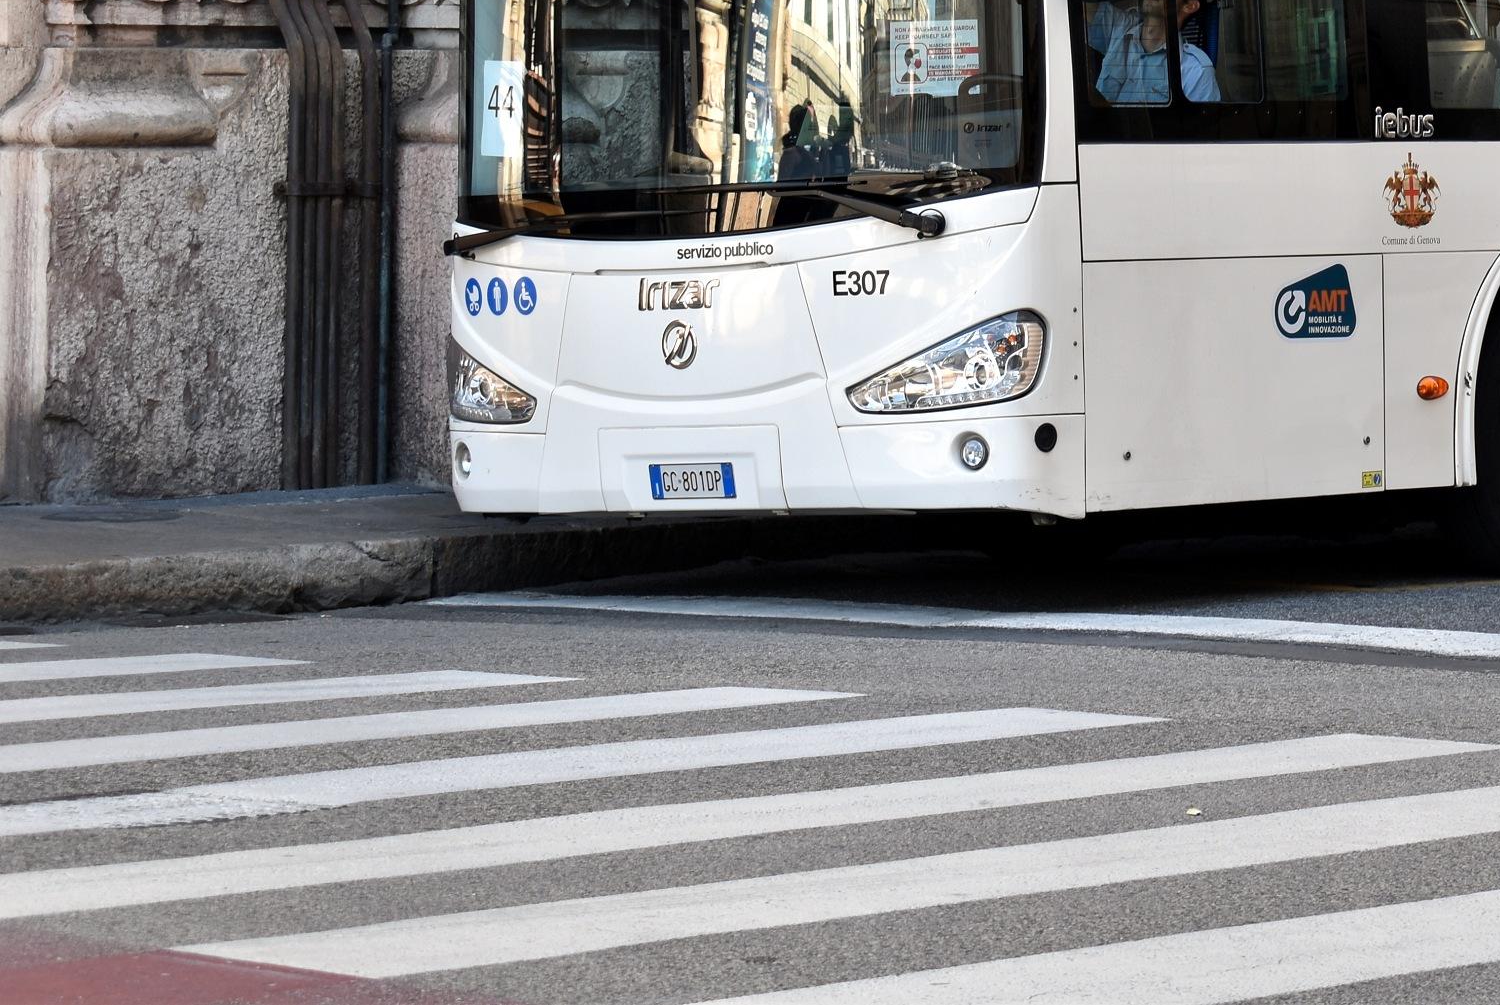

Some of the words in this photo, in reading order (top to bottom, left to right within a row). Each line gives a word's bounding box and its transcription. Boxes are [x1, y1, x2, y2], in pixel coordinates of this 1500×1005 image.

[487, 85, 515, 118] 44
[1375, 106, 1434, 139] iebus
[676, 244, 723, 260] servizio
[723, 241, 775, 260] pubblico
[1381, 236, 1408, 246] Comune
[1409, 235, 1416, 246] di
[1416, 235, 1441, 246] Genova
[637, 277, 722, 312] Irizar
[832, 269, 891, 297] E307
[1308, 289, 1348, 313] AMT
[1308, 314, 1337, 324] MOBILITÀ
[1337, 315, 1342, 323] E
[1308, 325, 1350, 334] INNOVAZIONE
